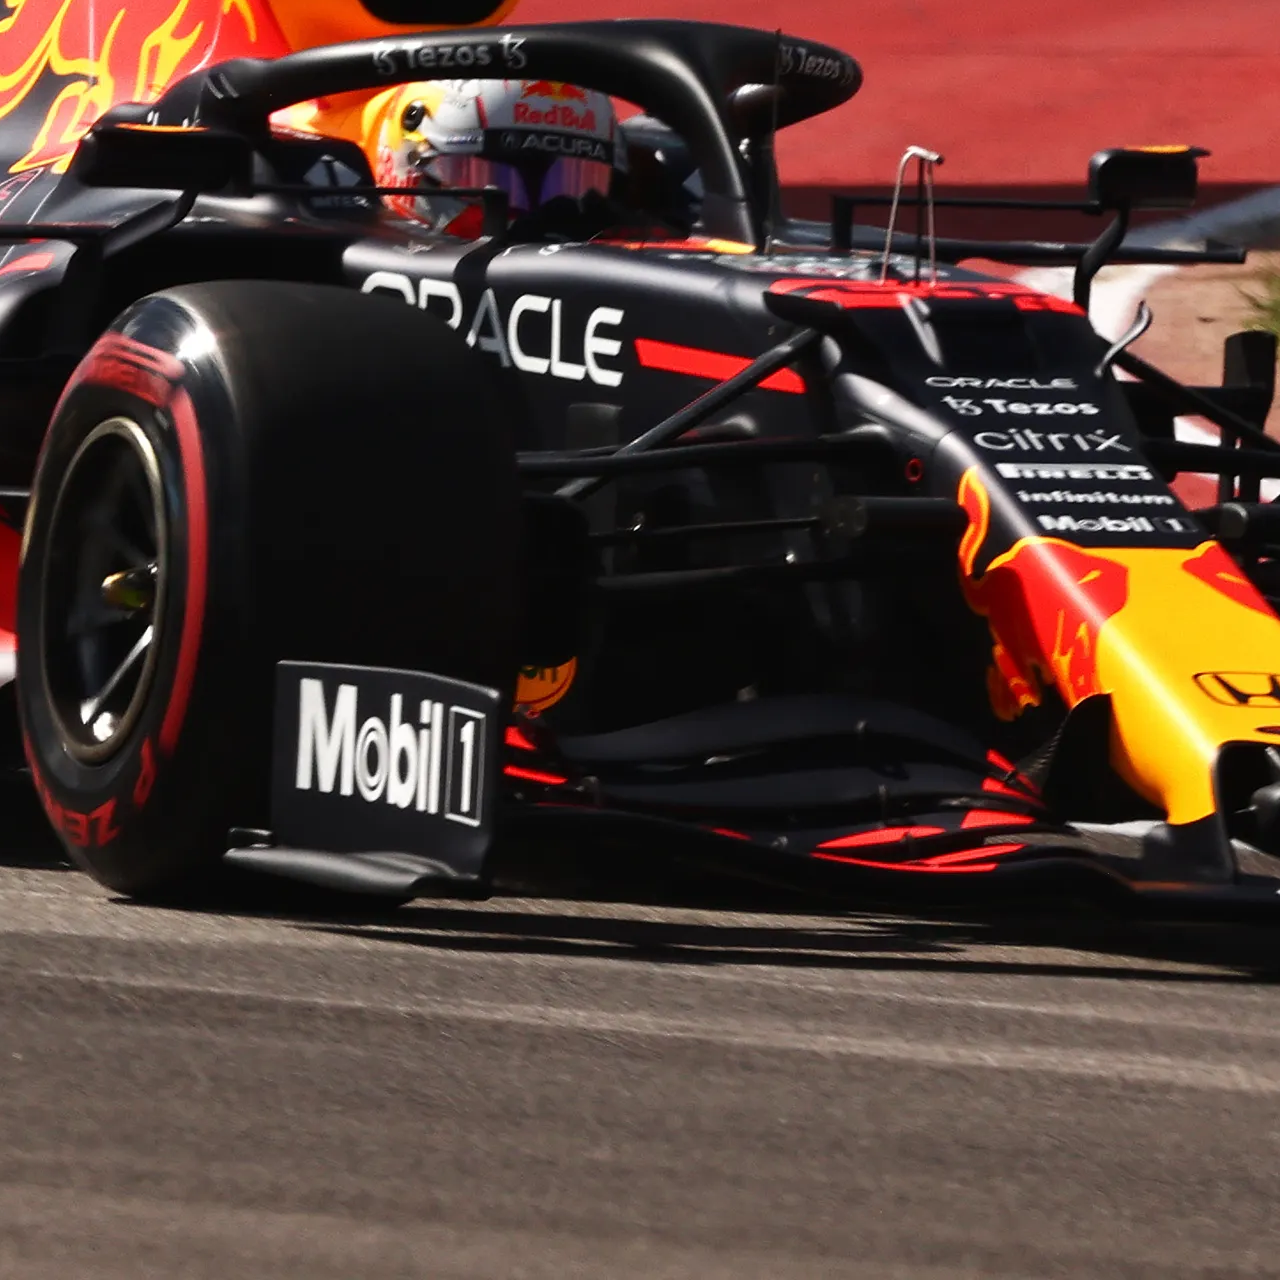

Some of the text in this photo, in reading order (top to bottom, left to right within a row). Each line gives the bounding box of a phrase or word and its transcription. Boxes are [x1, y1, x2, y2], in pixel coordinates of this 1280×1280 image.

[402, 41, 493, 69] Tezos
[522, 134, 607, 159] ACURA
[360, 271, 624, 387] ACLE
[924, 376, 1078, 389] ORACLE
[984, 398, 1100, 415] Tezos
[973, 428, 1131, 452] Citrix
[995, 463, 1154, 481] PIRELLI
[1017, 490, 1175, 505] infinitum
[1037, 515, 1155, 533] Mobil
[295, 677, 444, 815] Mobil
